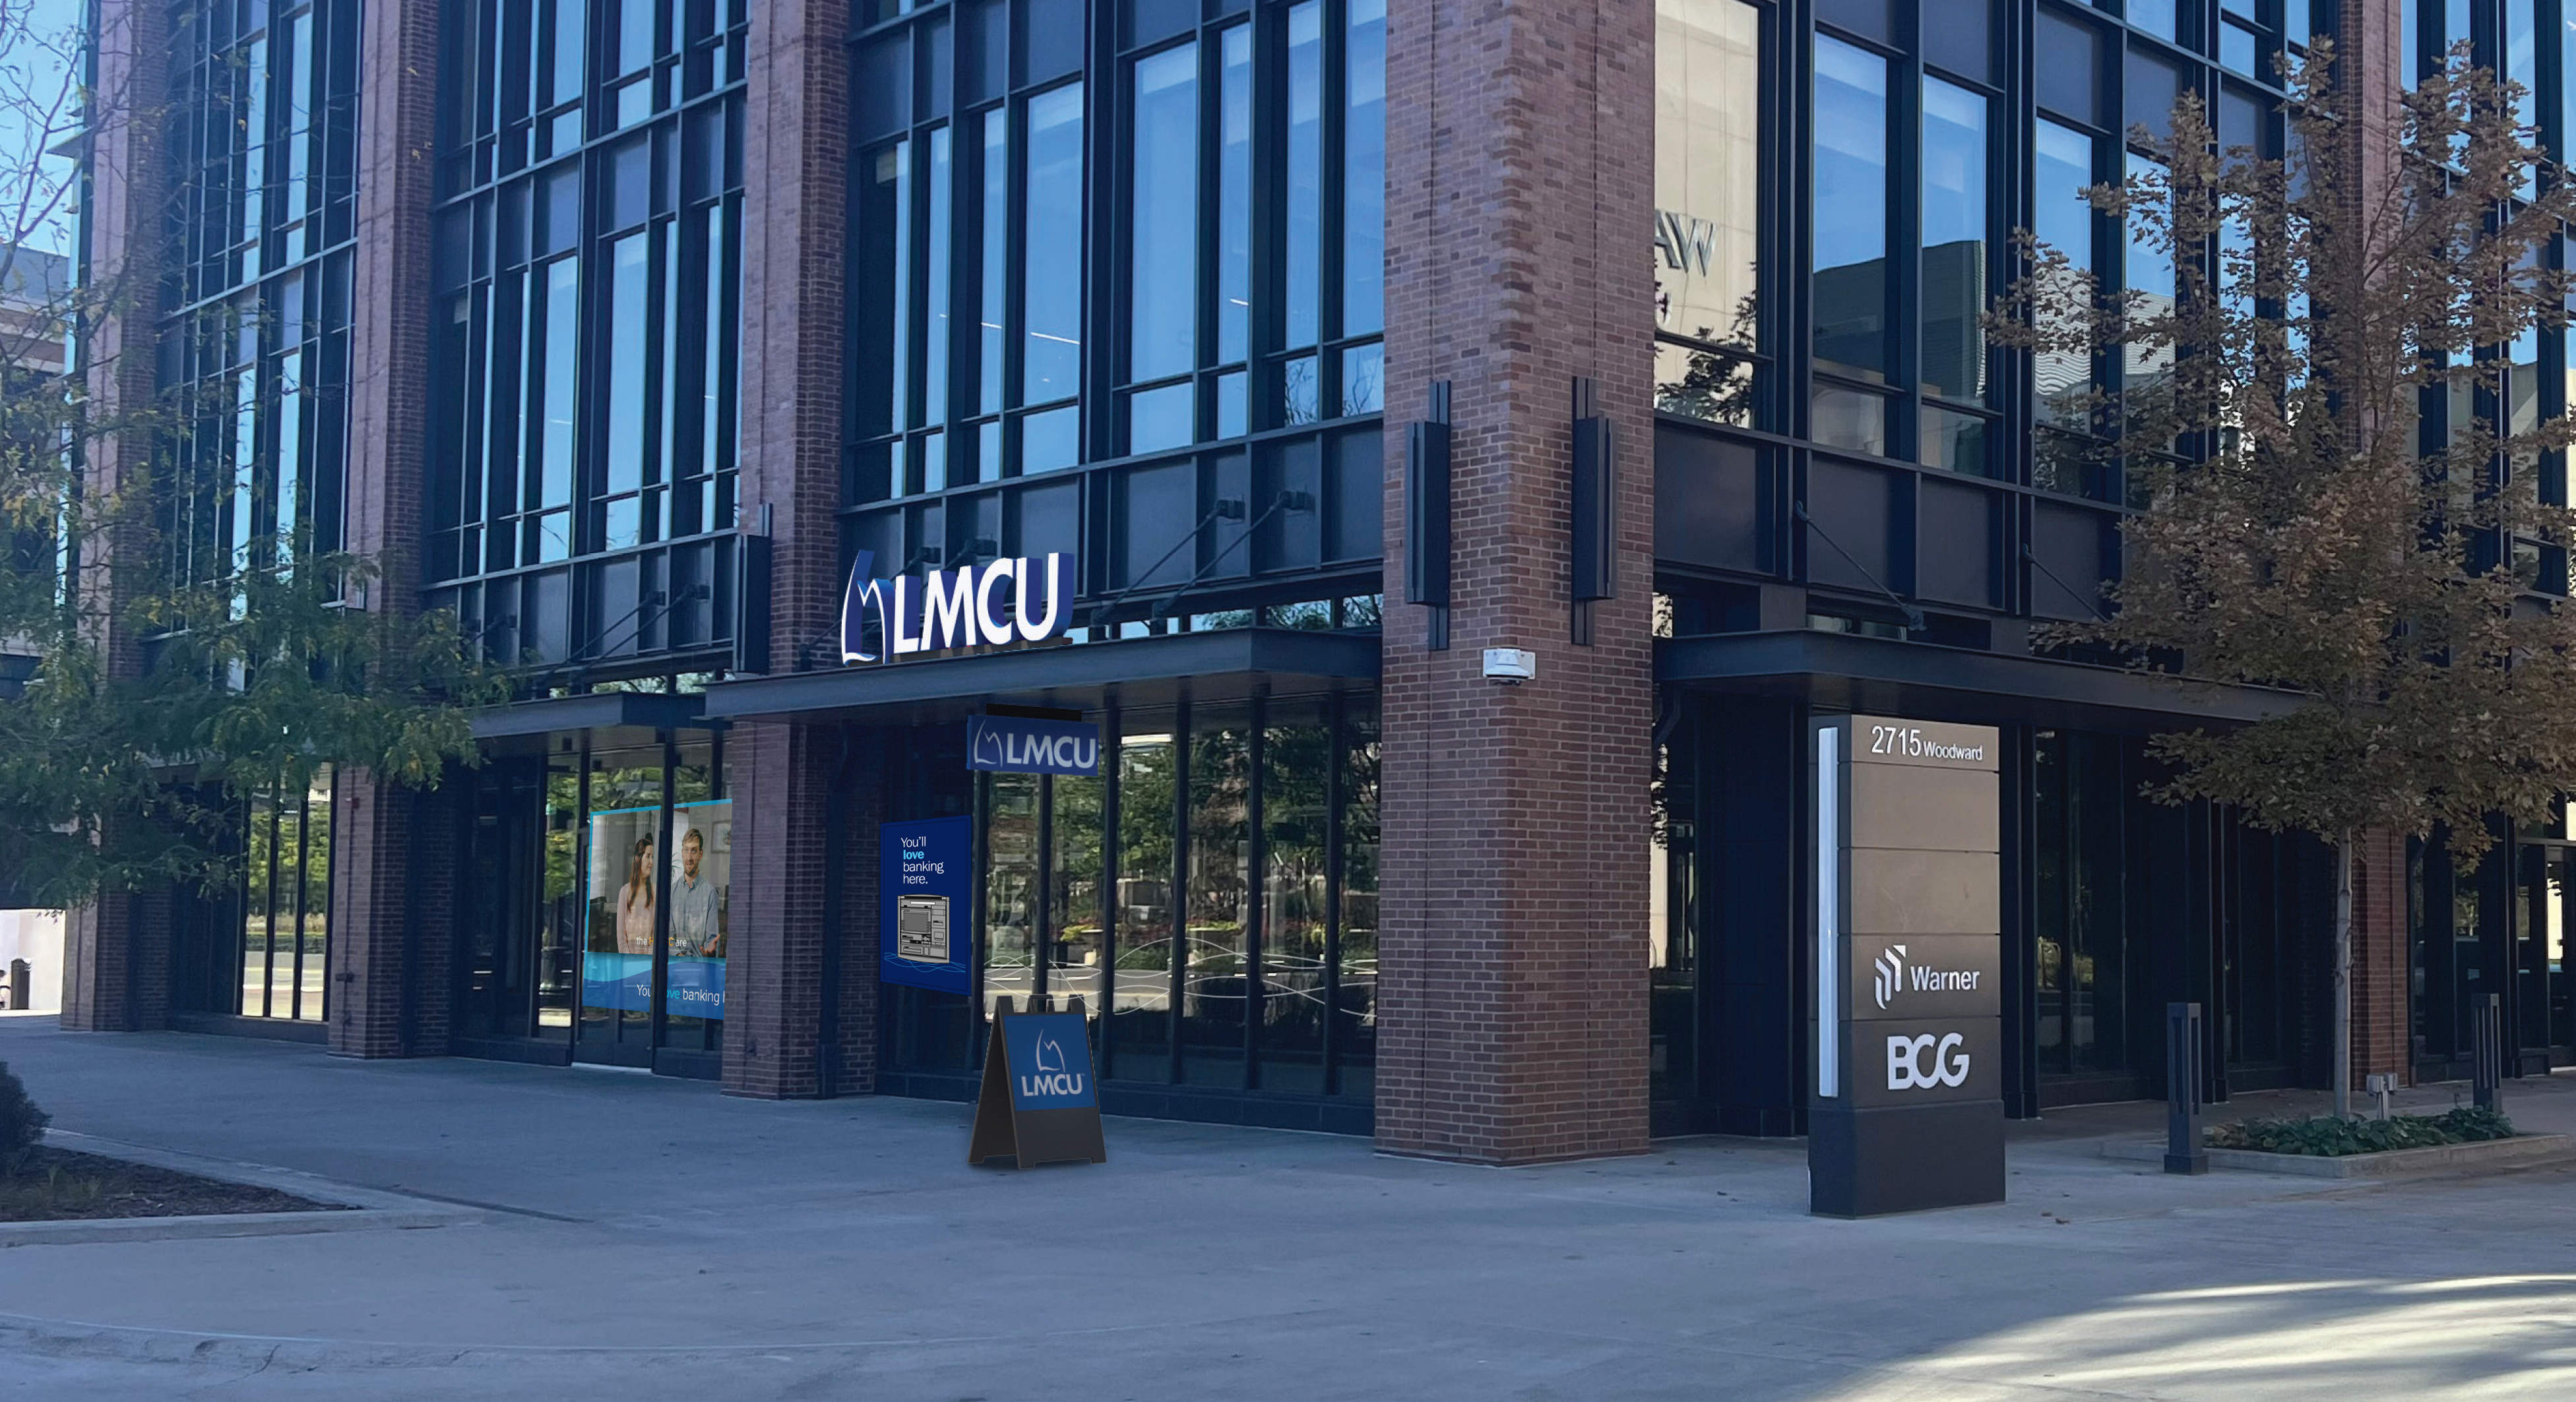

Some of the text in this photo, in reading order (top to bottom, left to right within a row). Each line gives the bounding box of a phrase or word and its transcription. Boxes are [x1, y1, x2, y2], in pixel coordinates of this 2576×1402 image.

[894, 553, 1061, 654] LMCU
[1007, 733, 1096, 769] LMCU
[1871, 726, 1983, 761] 2715 Woodward
[900, 836, 926, 848] You'll
[903, 849, 925, 860] love
[903, 861, 945, 874] banking
[903, 874, 928, 884] here.
[637, 936, 648, 946] the
[675, 938, 687, 947] are
[1910, 965, 1980, 991] Warner
[637, 984, 651, 997] You
[683, 988, 720, 1006] banking
[1887, 1033, 1970, 1090] BCG
[1021, 1073, 1083, 1097] LMCU
